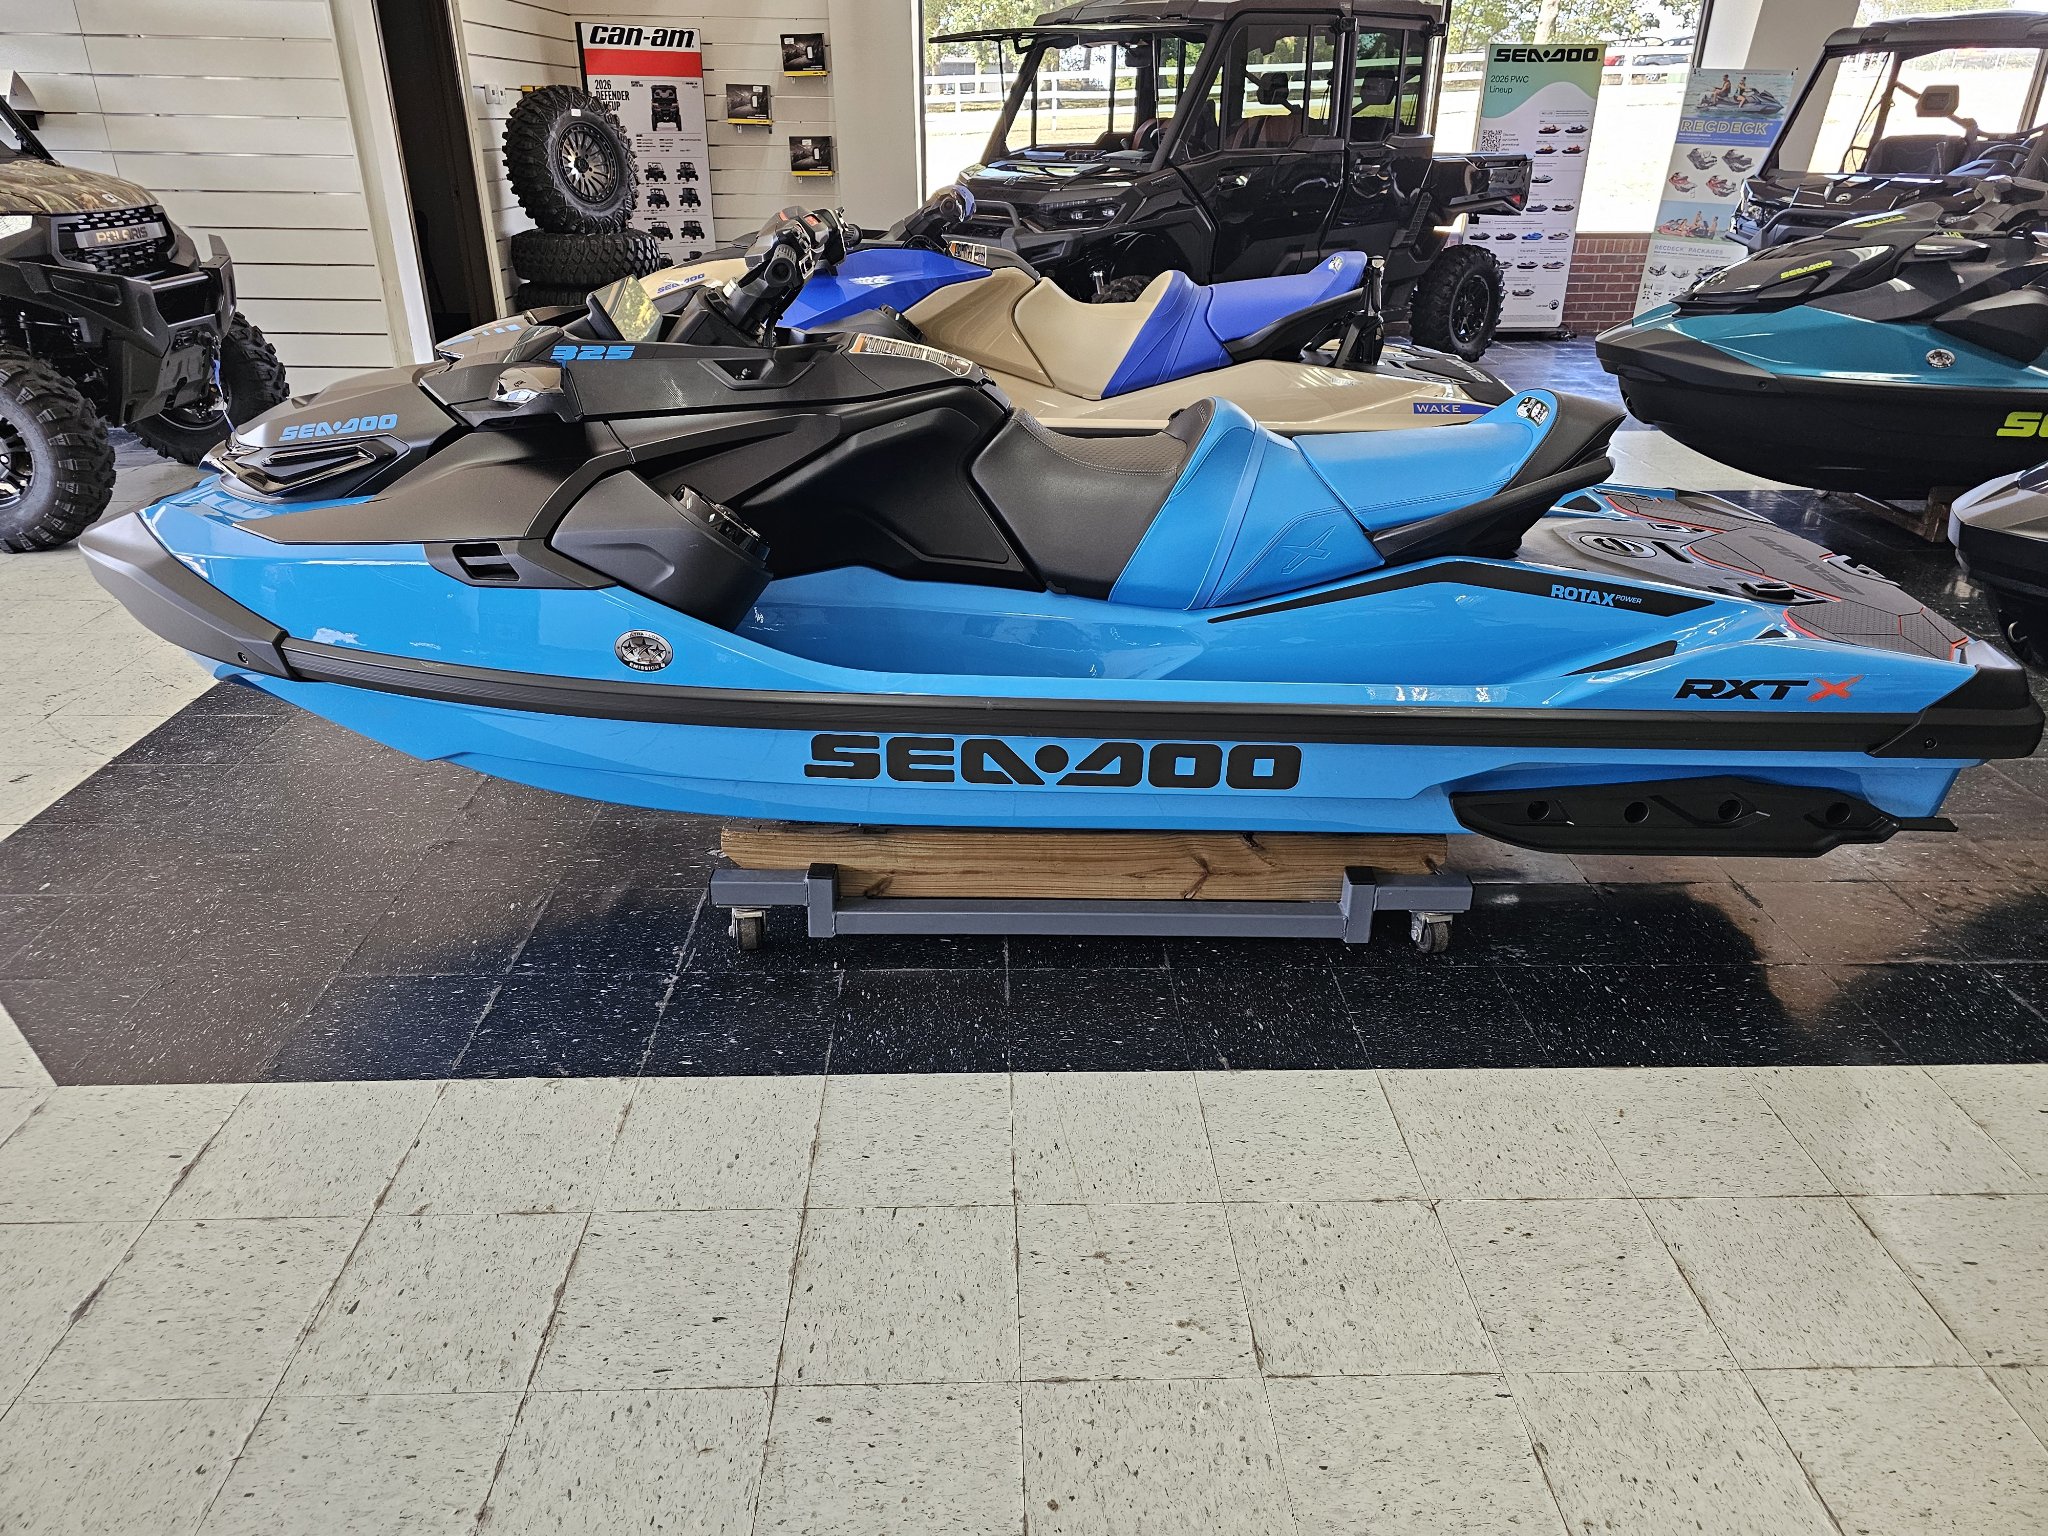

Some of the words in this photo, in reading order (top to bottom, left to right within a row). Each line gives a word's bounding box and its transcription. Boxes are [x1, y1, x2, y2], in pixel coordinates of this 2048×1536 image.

[589, 25, 694, 48] can-am
[595, 80, 611, 89] 2026
[1490, 75, 1509, 83] 2026
[1510, 75, 1529, 83] PWC
[596, 91, 629, 100] DEFENDER
[1489, 86, 1513, 94] Lineup
[1680, 120, 1767, 135] RECDECK
[95, 226, 148, 244] POLARIS
[550, 345, 635, 360] 325
[1417, 403, 1461, 414] WAKE
[1550, 584, 1616, 607] ROTAX
[1614, 594, 1642, 604] POWER
